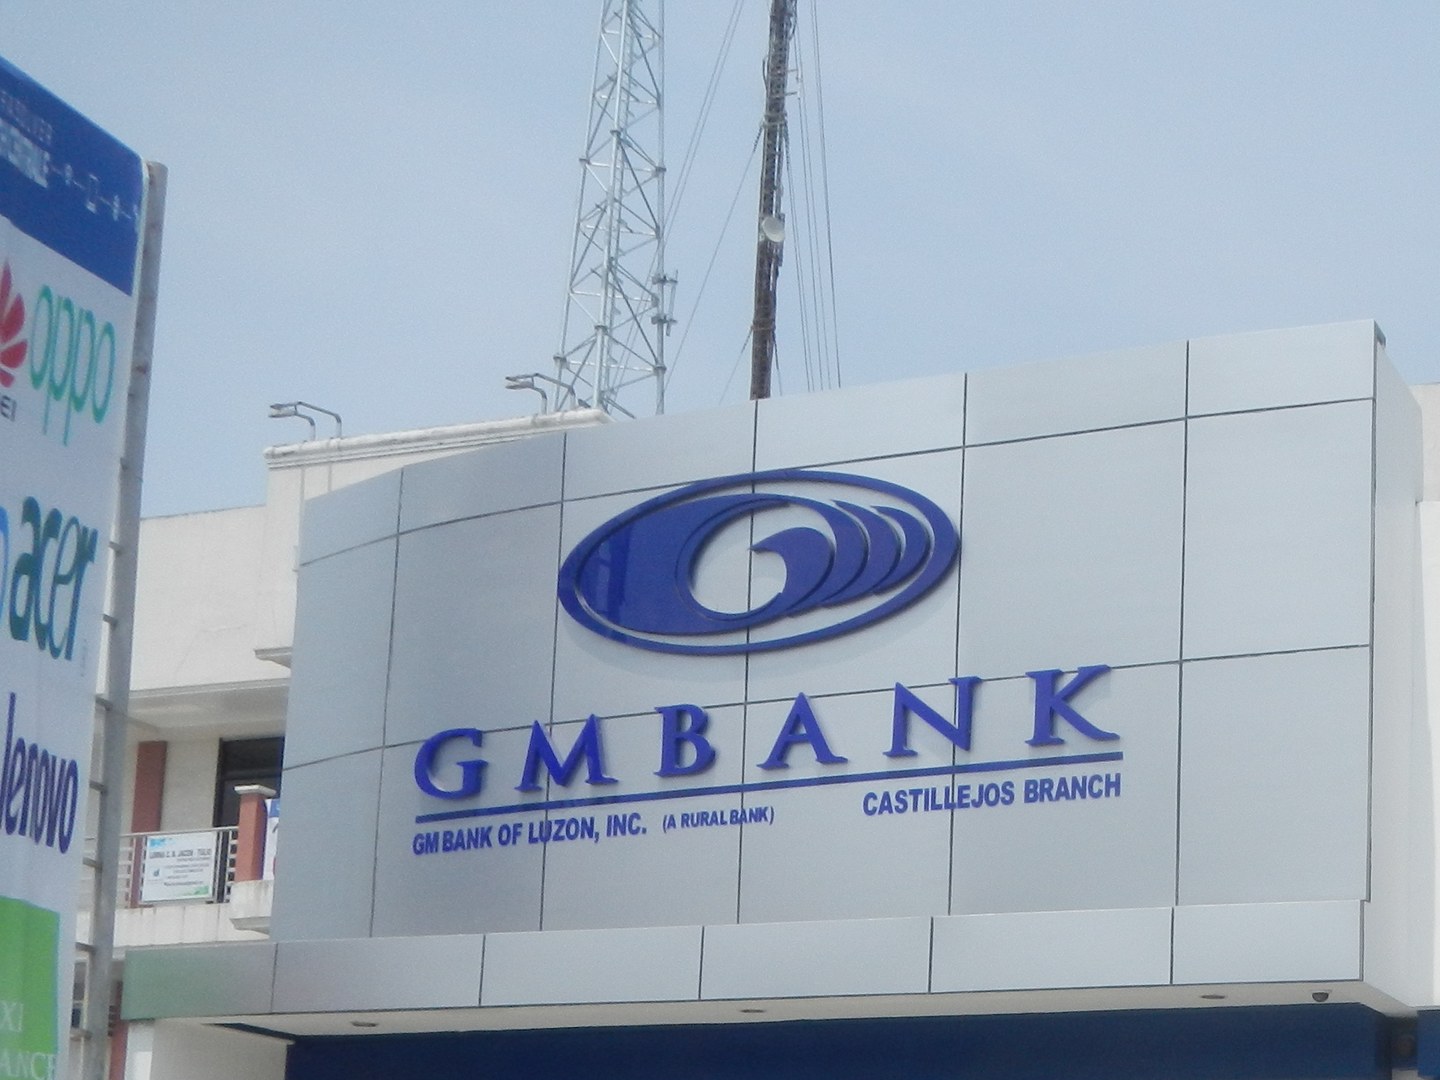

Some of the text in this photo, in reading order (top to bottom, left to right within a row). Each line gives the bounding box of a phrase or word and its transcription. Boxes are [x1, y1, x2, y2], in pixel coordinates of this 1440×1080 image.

[30, 284, 115, 447] oppo
[9, 496, 98, 660] acer
[0, 692, 78, 854] lenovo
[498, 822, 523, 846] OF
[528, 816, 599, 844] LUZON,
[606, 812, 647, 838] INC.
[662, 813, 677, 834] (A
[680, 808, 727, 830] RURAL
[729, 805, 775, 826] BANK)
[863, 773, 1121, 816] CASTILLEJOS BRANCH
